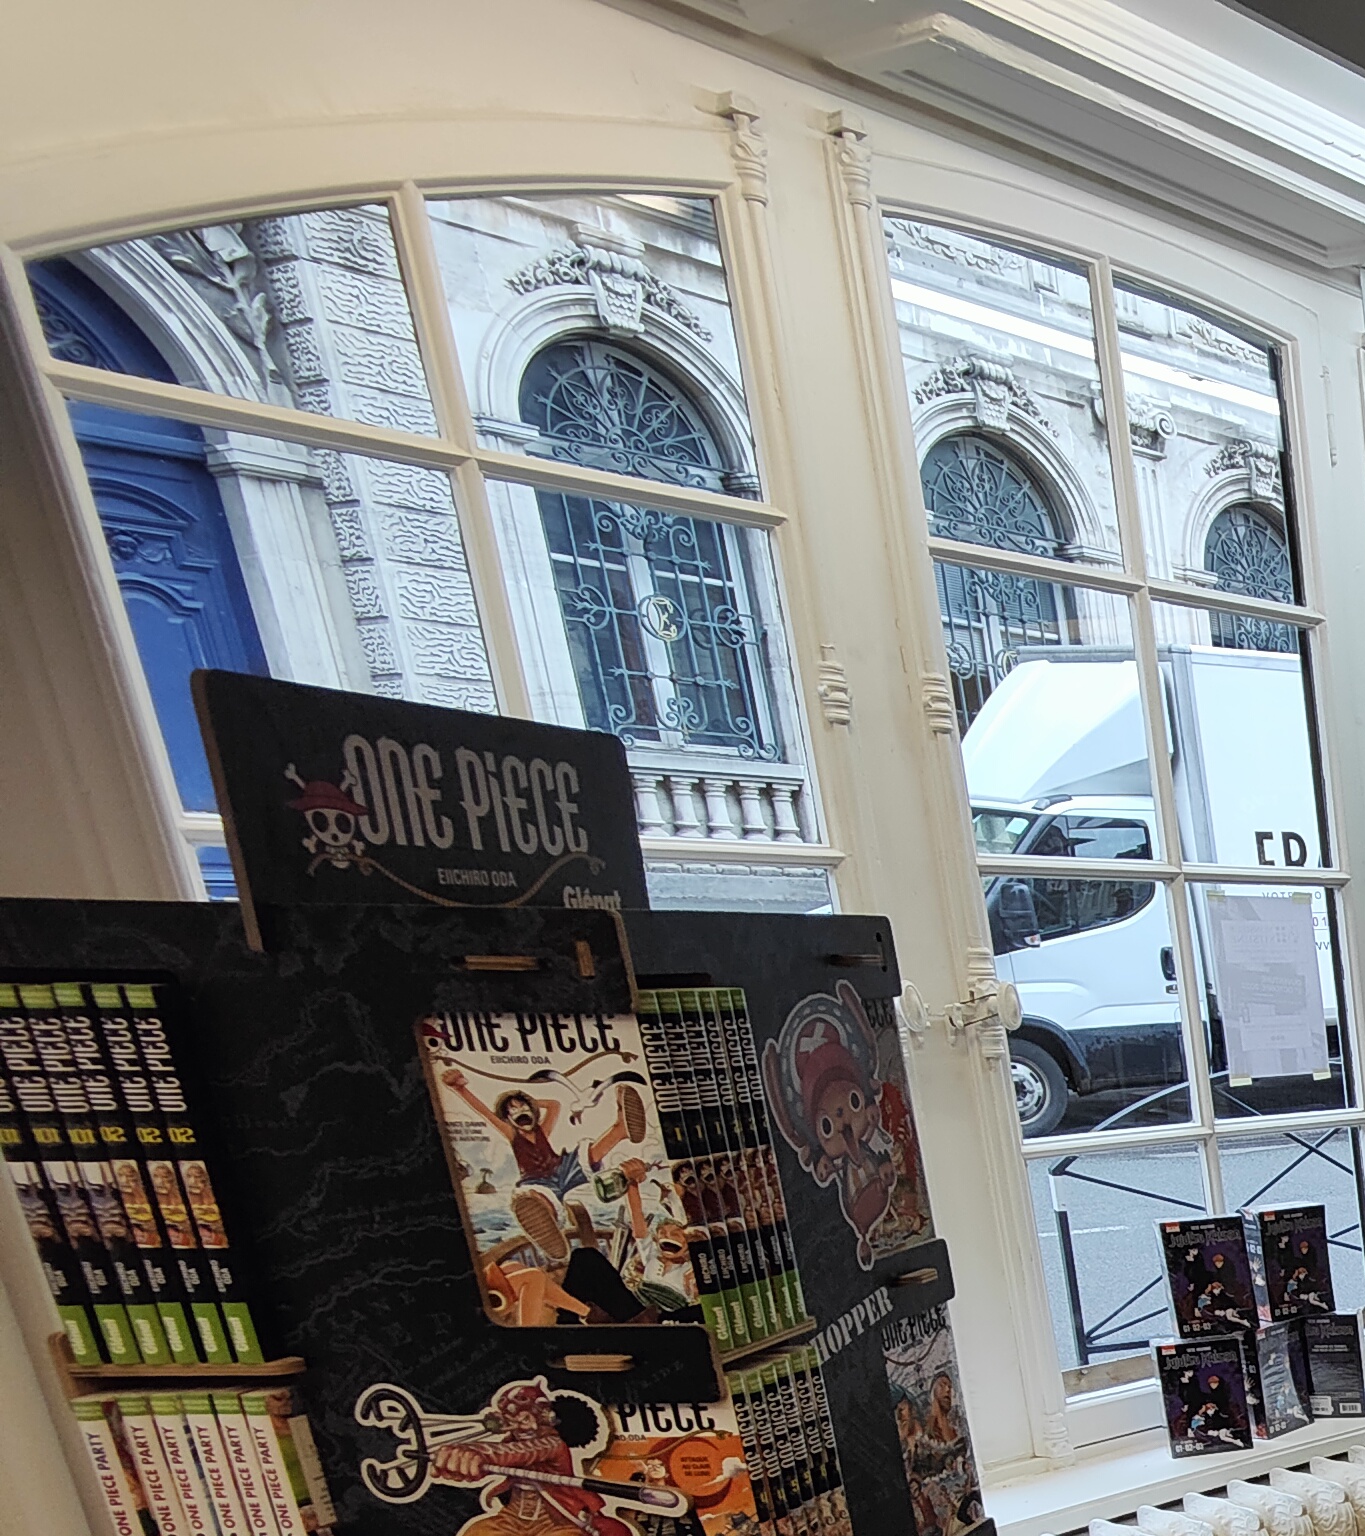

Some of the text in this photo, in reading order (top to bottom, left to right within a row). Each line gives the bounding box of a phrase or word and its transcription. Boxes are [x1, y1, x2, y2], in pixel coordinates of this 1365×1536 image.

[343, 734, 589, 856] ONE PIECE
[437, 868, 517, 888] EIICHIRO ODA
[530, 1056, 552, 1065] ODA
[641, 1022, 682, 1113] ONE PIECE
[809, 1286, 894, 1364] HOPPER
[88, 1432, 132, 1536] ONE PIECE PARTY
[131, 1426, 176, 1532] ONE PIECE PARTY
[163, 1427, 204, 1530] ONE PIECE PARTY
[198, 1426, 236, 1528] ONE PIECE PARTY
[226, 1426, 266, 1528] ONE PIECE PARTY
[254, 1427, 293, 1529] ONE PIECE PARTY
